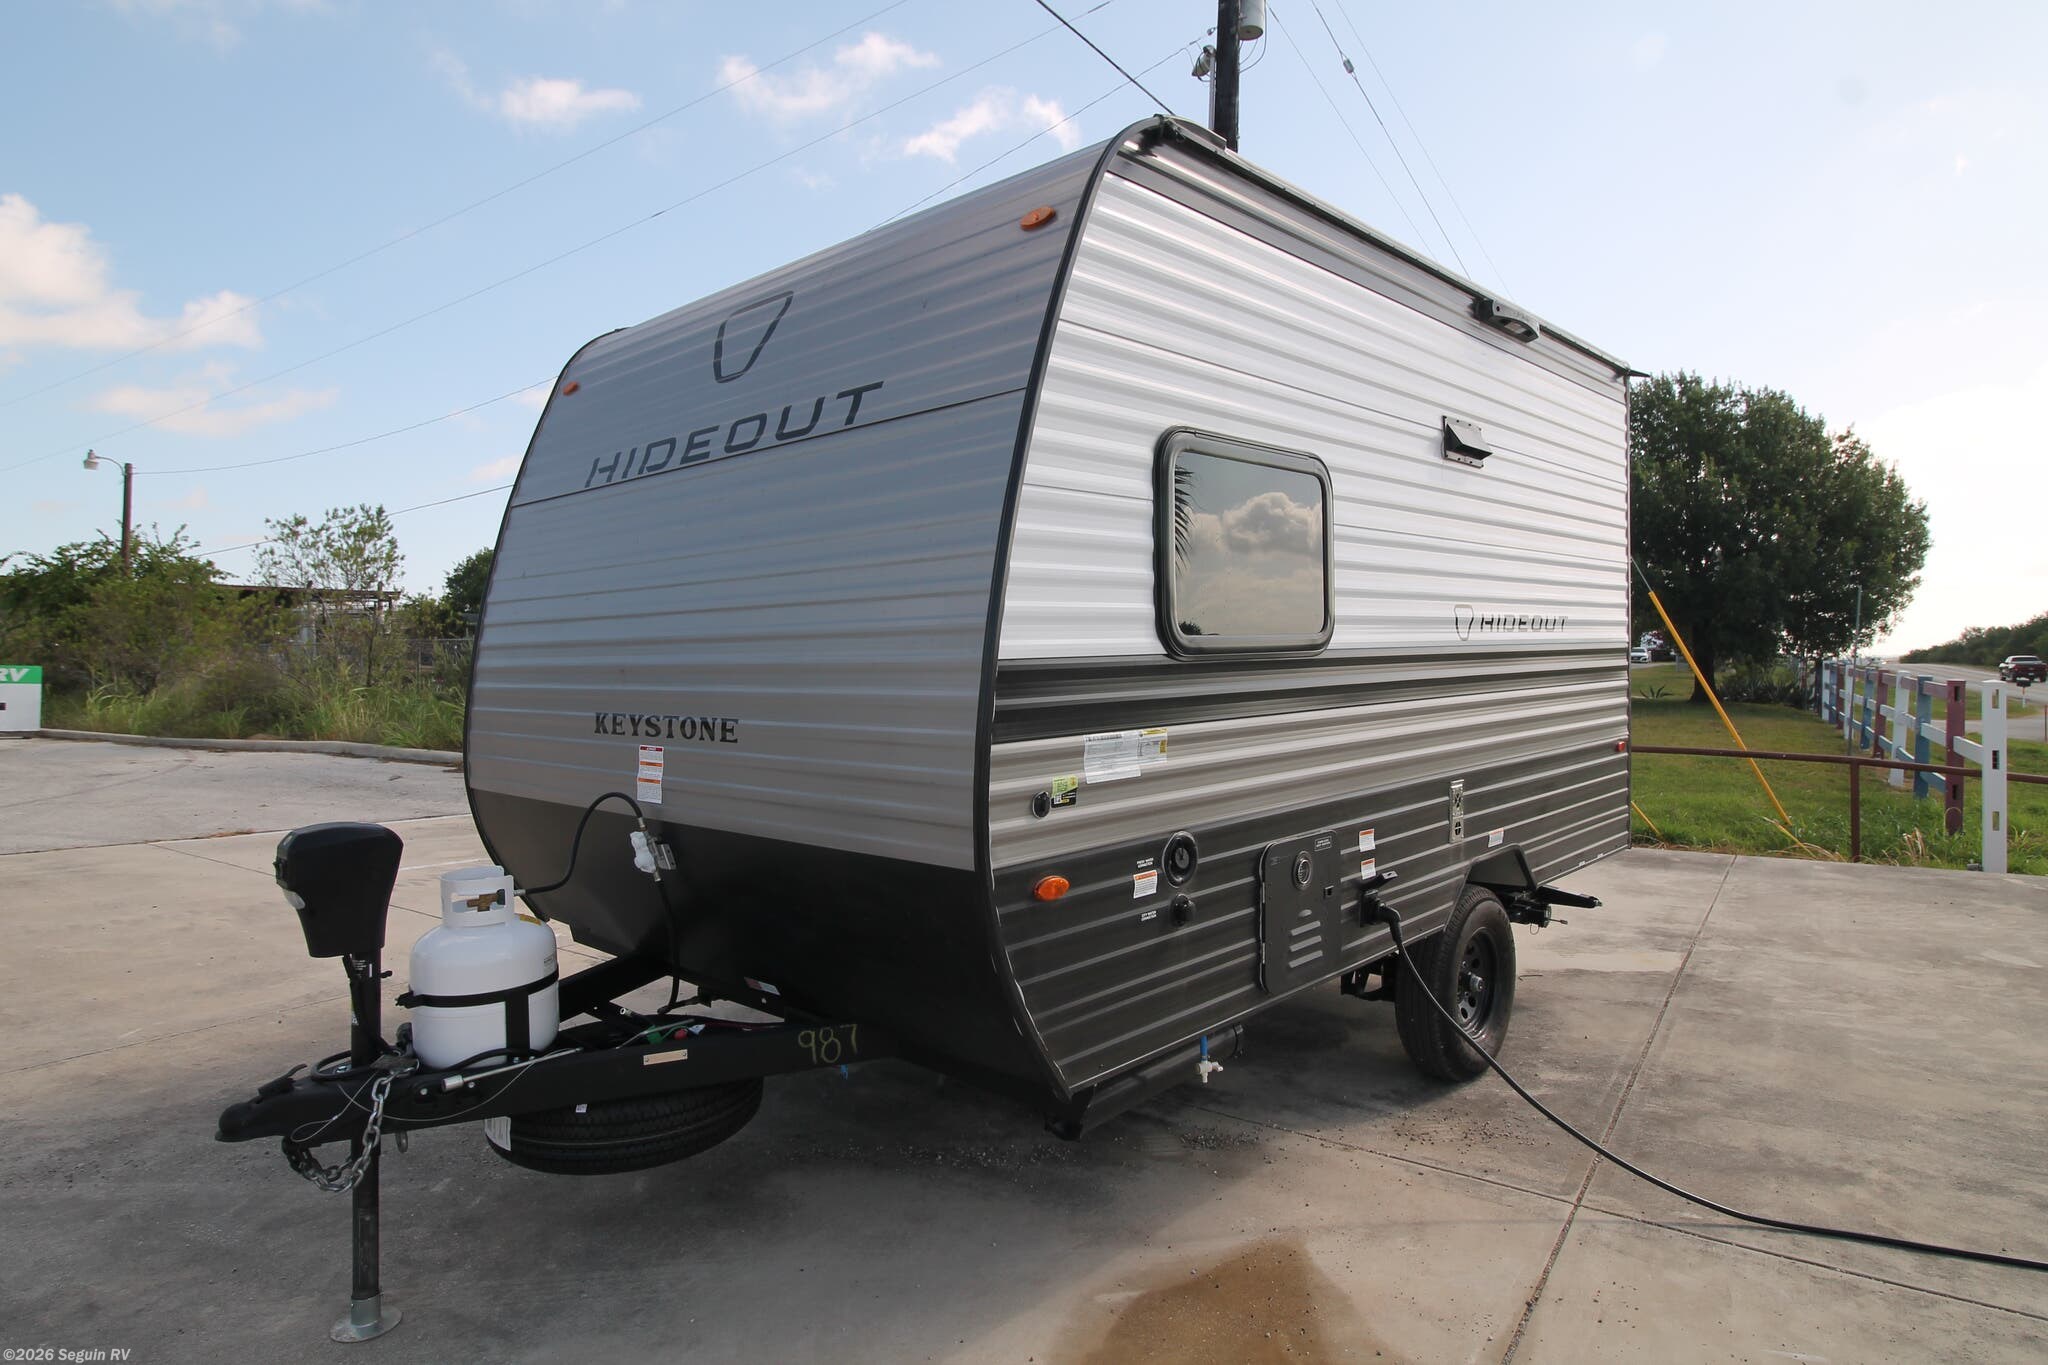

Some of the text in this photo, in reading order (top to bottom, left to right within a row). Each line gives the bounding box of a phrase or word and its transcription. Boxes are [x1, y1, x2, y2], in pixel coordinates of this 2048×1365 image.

[584, 381, 884, 488] HIDEOUT
[1480, 613, 1569, 633] HIDEOUT
[594, 711, 740, 744] KEYSTONE
[798, 1023, 858, 1064] 987
